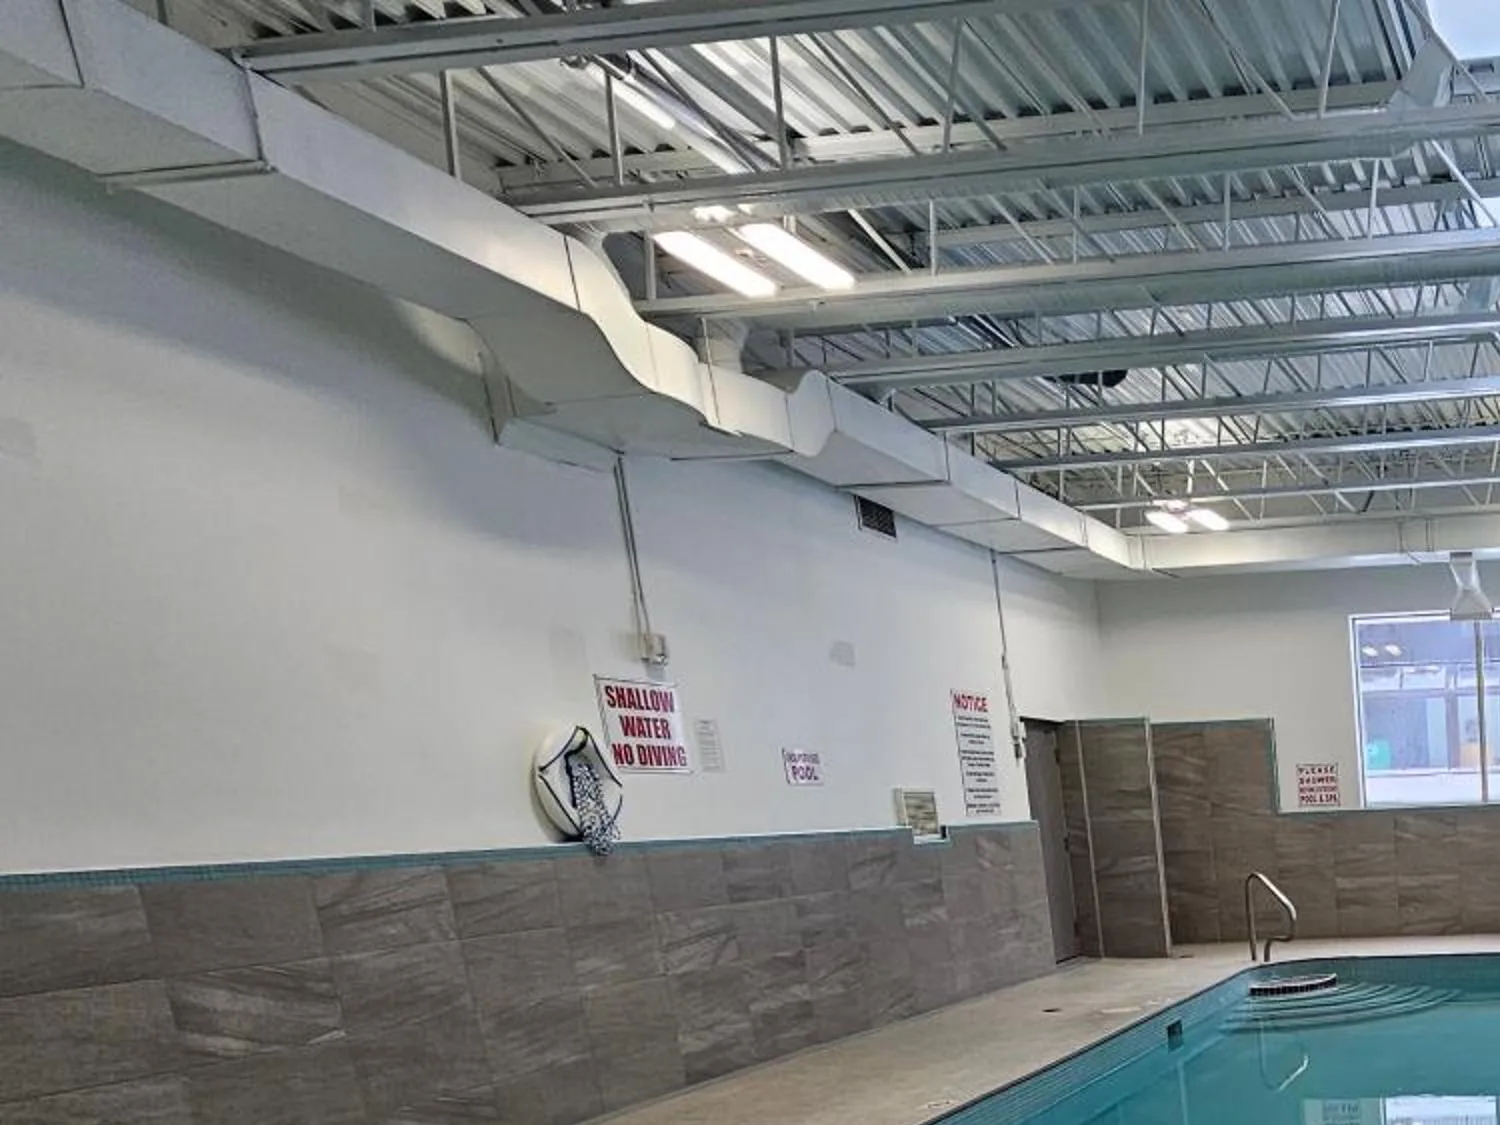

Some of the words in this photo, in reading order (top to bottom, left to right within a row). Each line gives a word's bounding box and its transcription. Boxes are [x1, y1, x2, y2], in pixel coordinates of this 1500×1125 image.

[604, 685, 675, 713] SHALLOW
[954, 693, 988, 712] NOTICE
[619, 715, 671, 739] WATER
[611, 743, 634, 765] NO
[636, 743, 688, 767] DIVING
[791, 765, 819, 781] POOL
